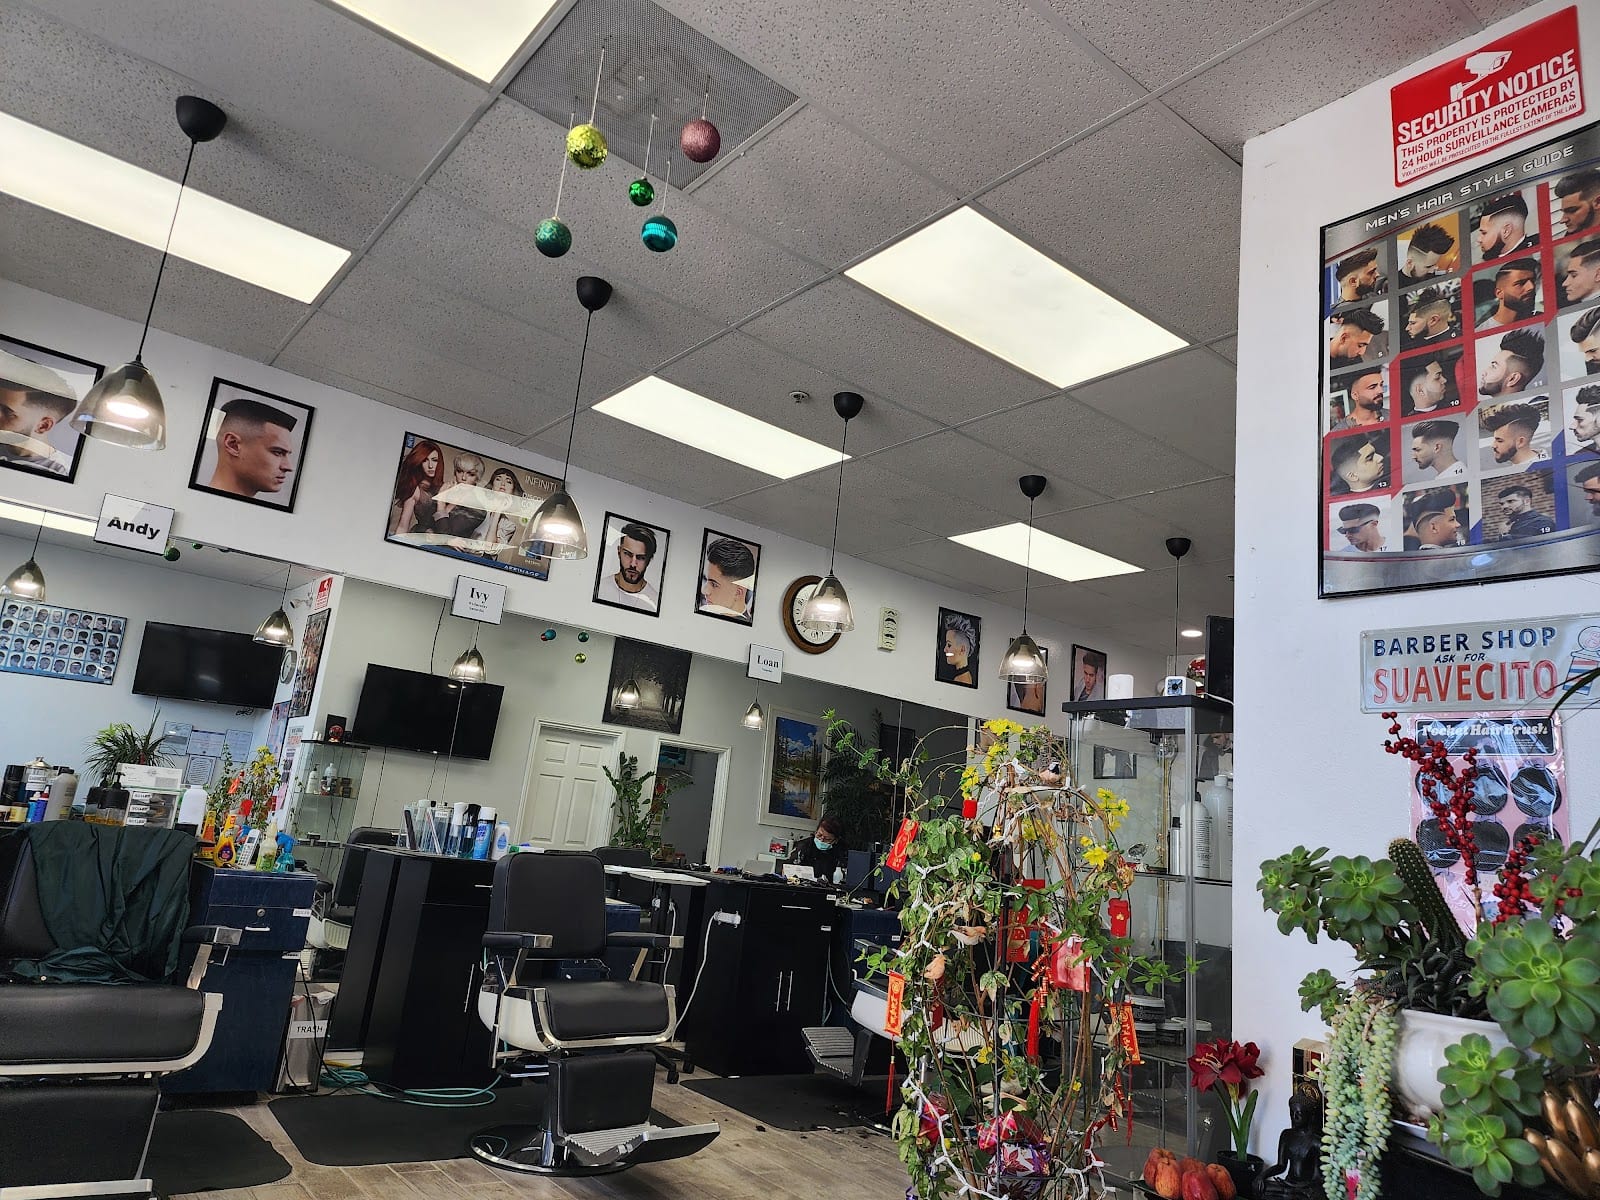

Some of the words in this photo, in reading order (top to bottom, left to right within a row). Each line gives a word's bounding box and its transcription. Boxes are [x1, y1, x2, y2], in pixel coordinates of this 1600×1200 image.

[1398, 86, 1493, 143] SECURITY
[1499, 48, 1576, 99] NOTICE
[1401, 140, 1424, 158] THIS
[1427, 120, 1478, 149] PROPERTY
[1481, 115, 1490, 126] IS
[1494, 86, 1558, 120] PROTECTED
[1561, 77, 1574, 92] BY
[1401, 157, 1414, 170] 24
[1416, 147, 1443, 163] HOUR
[1445, 118, 1520, 153] SURVEILLANCE
[1523, 91, 1576, 120] CAMERAS
[1402, 165, 1428, 177] VIOLATORS
[1449, 143, 1481, 161] PROSECUTED
[1490, 135, 1499, 144] THE
[1501, 127, 1522, 139] FULLEST
[1523, 118, 1544, 131] EXTENT
[1553, 109, 1563, 118] THE
[1565, 103, 1577, 114] LAW
[1365, 207, 1410, 232] MEN'S
[1416, 192, 1453, 213] HAIR
[1460, 168, 1515, 196] STYLE
[1522, 145, 1574, 173] GUIDE
[107, 517, 160, 539] Andy
[470, 588, 489, 603] Ivy
[1373, 633, 1469, 656] BARBER
[1481, 627, 1556, 649] SHOP
[758, 656, 779, 668] Loan
[1435, 655, 1455, 664] ASK
[1464, 653, 1485, 661] FOR
[1373, 660, 1557, 704] SUAVECITO
[1422, 725, 1469, 737] Pocket
[1470, 725, 1502, 736] Hair
[1506, 723, 1547, 735] Brush
[297, 1025, 323, 1033] TRASH
